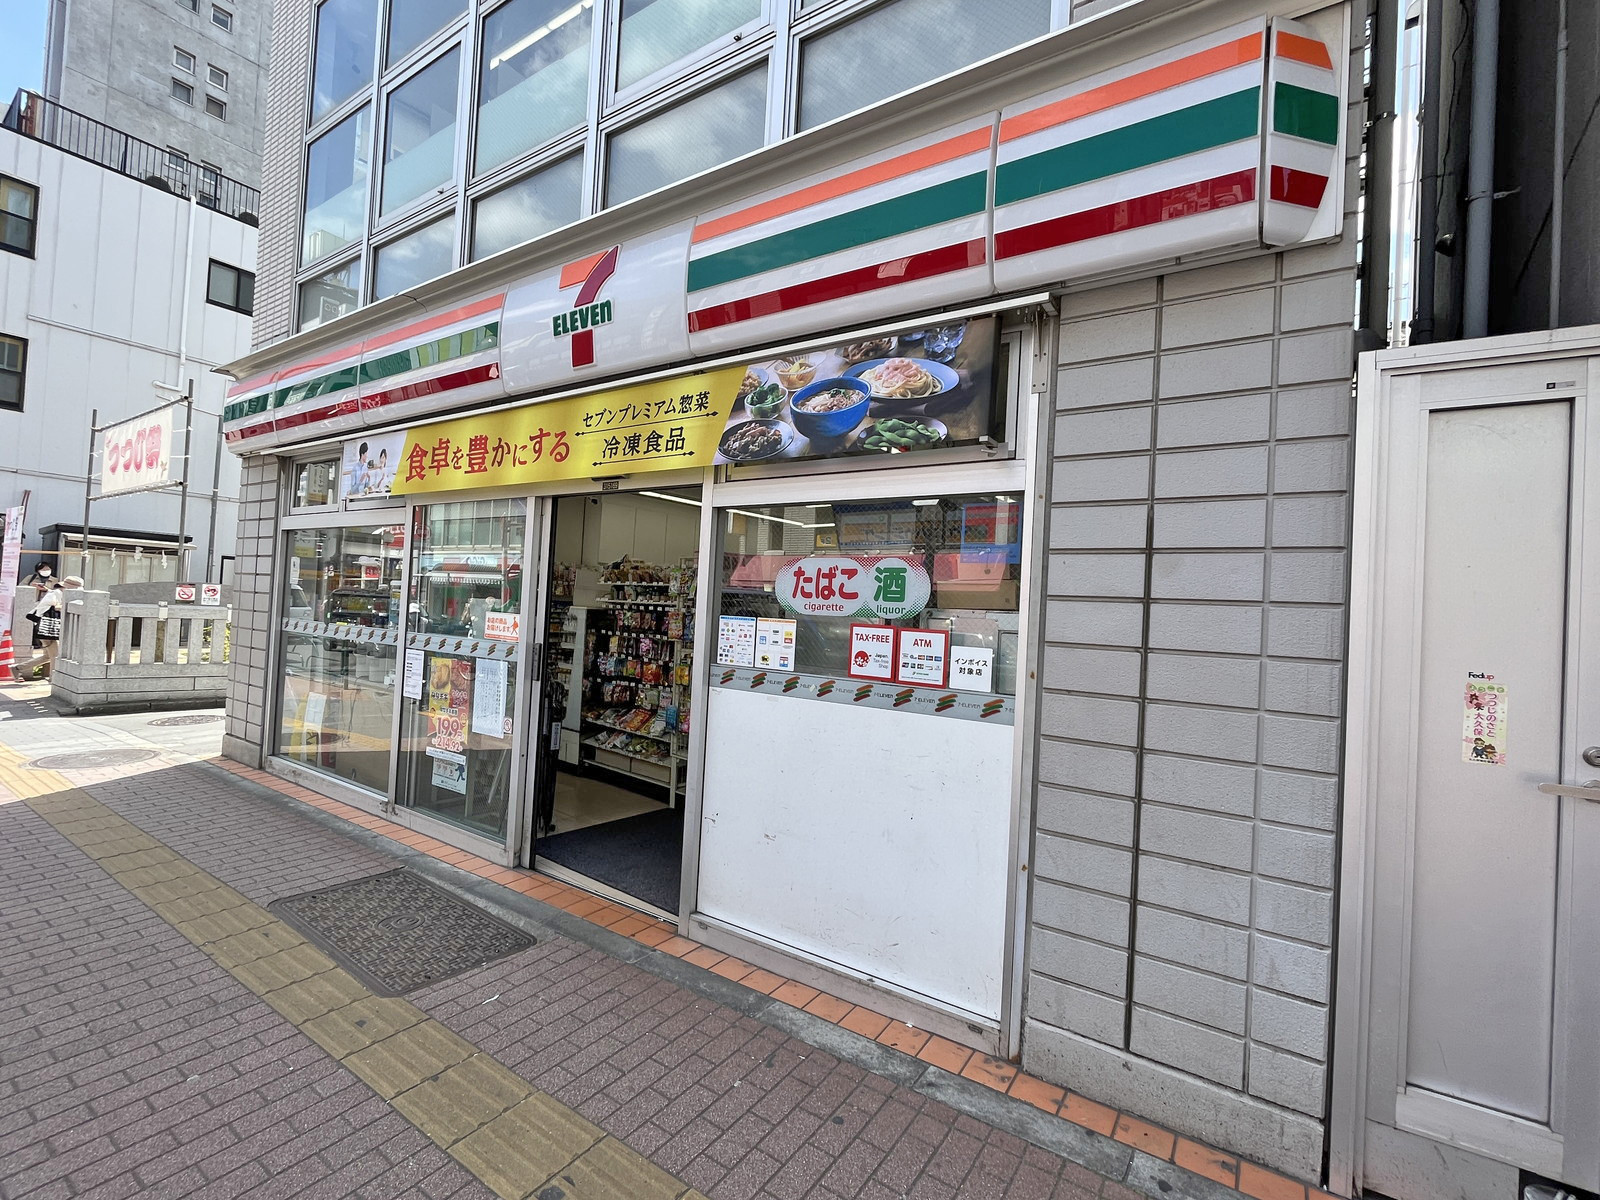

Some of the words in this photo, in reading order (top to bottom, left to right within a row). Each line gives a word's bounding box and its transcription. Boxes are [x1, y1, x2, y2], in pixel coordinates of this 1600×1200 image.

[583, 390, 710, 428] セブンプレミアム惣菜
[602, 426, 686, 459] 冷凍食品
[405, 427, 570, 483] 食卓を豊かにする
[792, 565, 859, 601] たばこ
[873, 566, 908, 603] 酒
[804, 602, 844, 612] cigarette
[876, 604, 906, 615] liquor
[855, 633, 890, 643] TAX-FREE
[912, 638, 932, 648] ATM
[954, 658, 988, 667] インボイス
[959, 667, 983, 676] 対象店
[1468, 672, 1494, 681] Fedup
[1473, 712, 1485, 737] 大久保
[1486, 693, 1497, 738] つつじのさと
